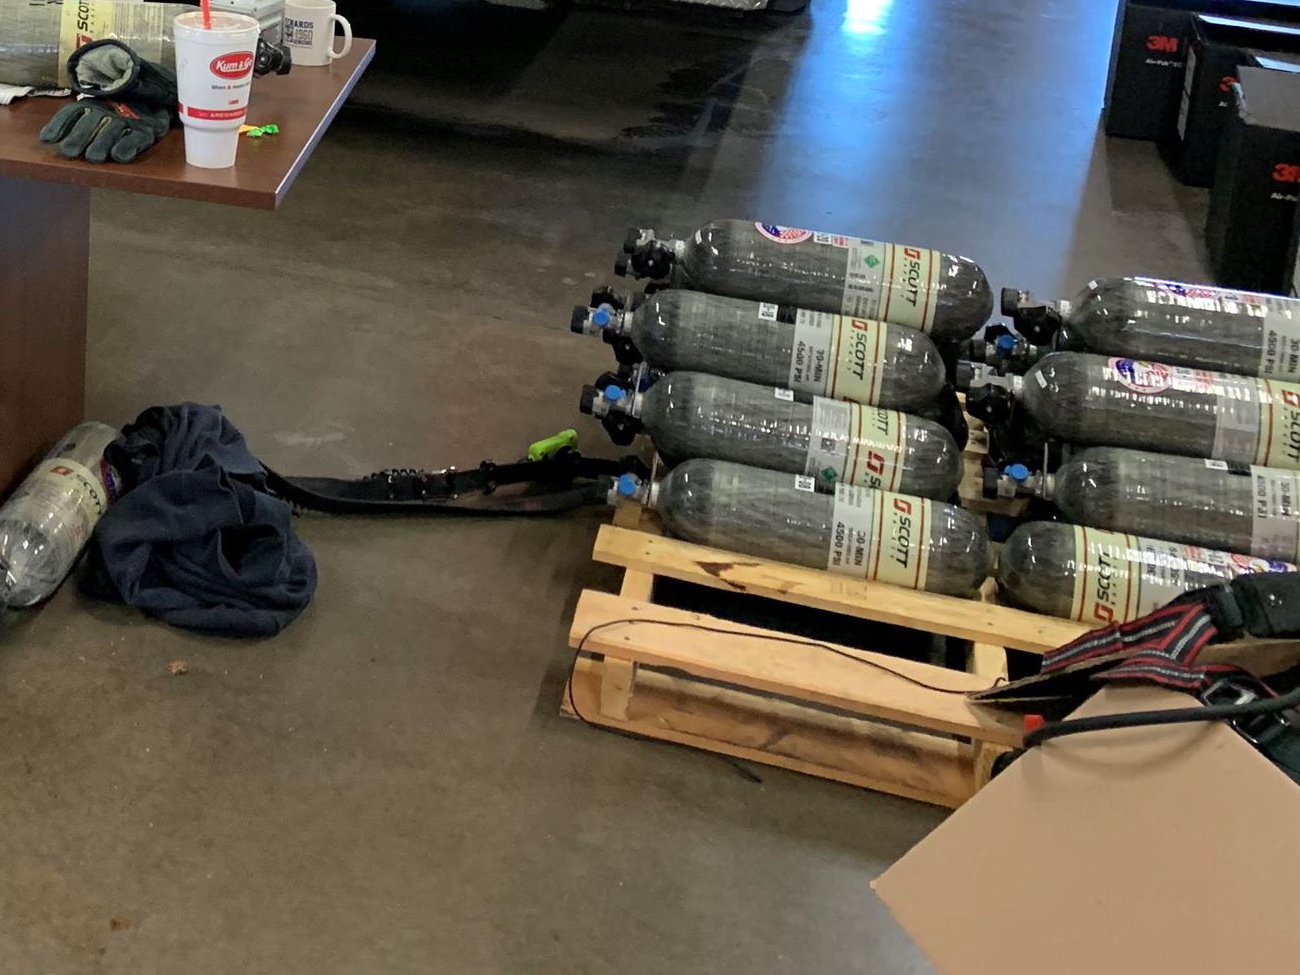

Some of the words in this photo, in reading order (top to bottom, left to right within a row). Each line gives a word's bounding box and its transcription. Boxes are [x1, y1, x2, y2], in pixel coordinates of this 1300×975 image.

[1147, 35, 1178, 53] 3M
[215, 60, 238, 71] Kum
[795, 340, 806, 365] 4500
[853, 332, 867, 380] SCOTT
[794, 368, 803, 383] PSI
[1287, 411, 1300, 464] SCOTT
[835, 521, 846, 548] 4500
[897, 515, 911, 568] SCOTT
[832, 551, 842, 566] PSI
